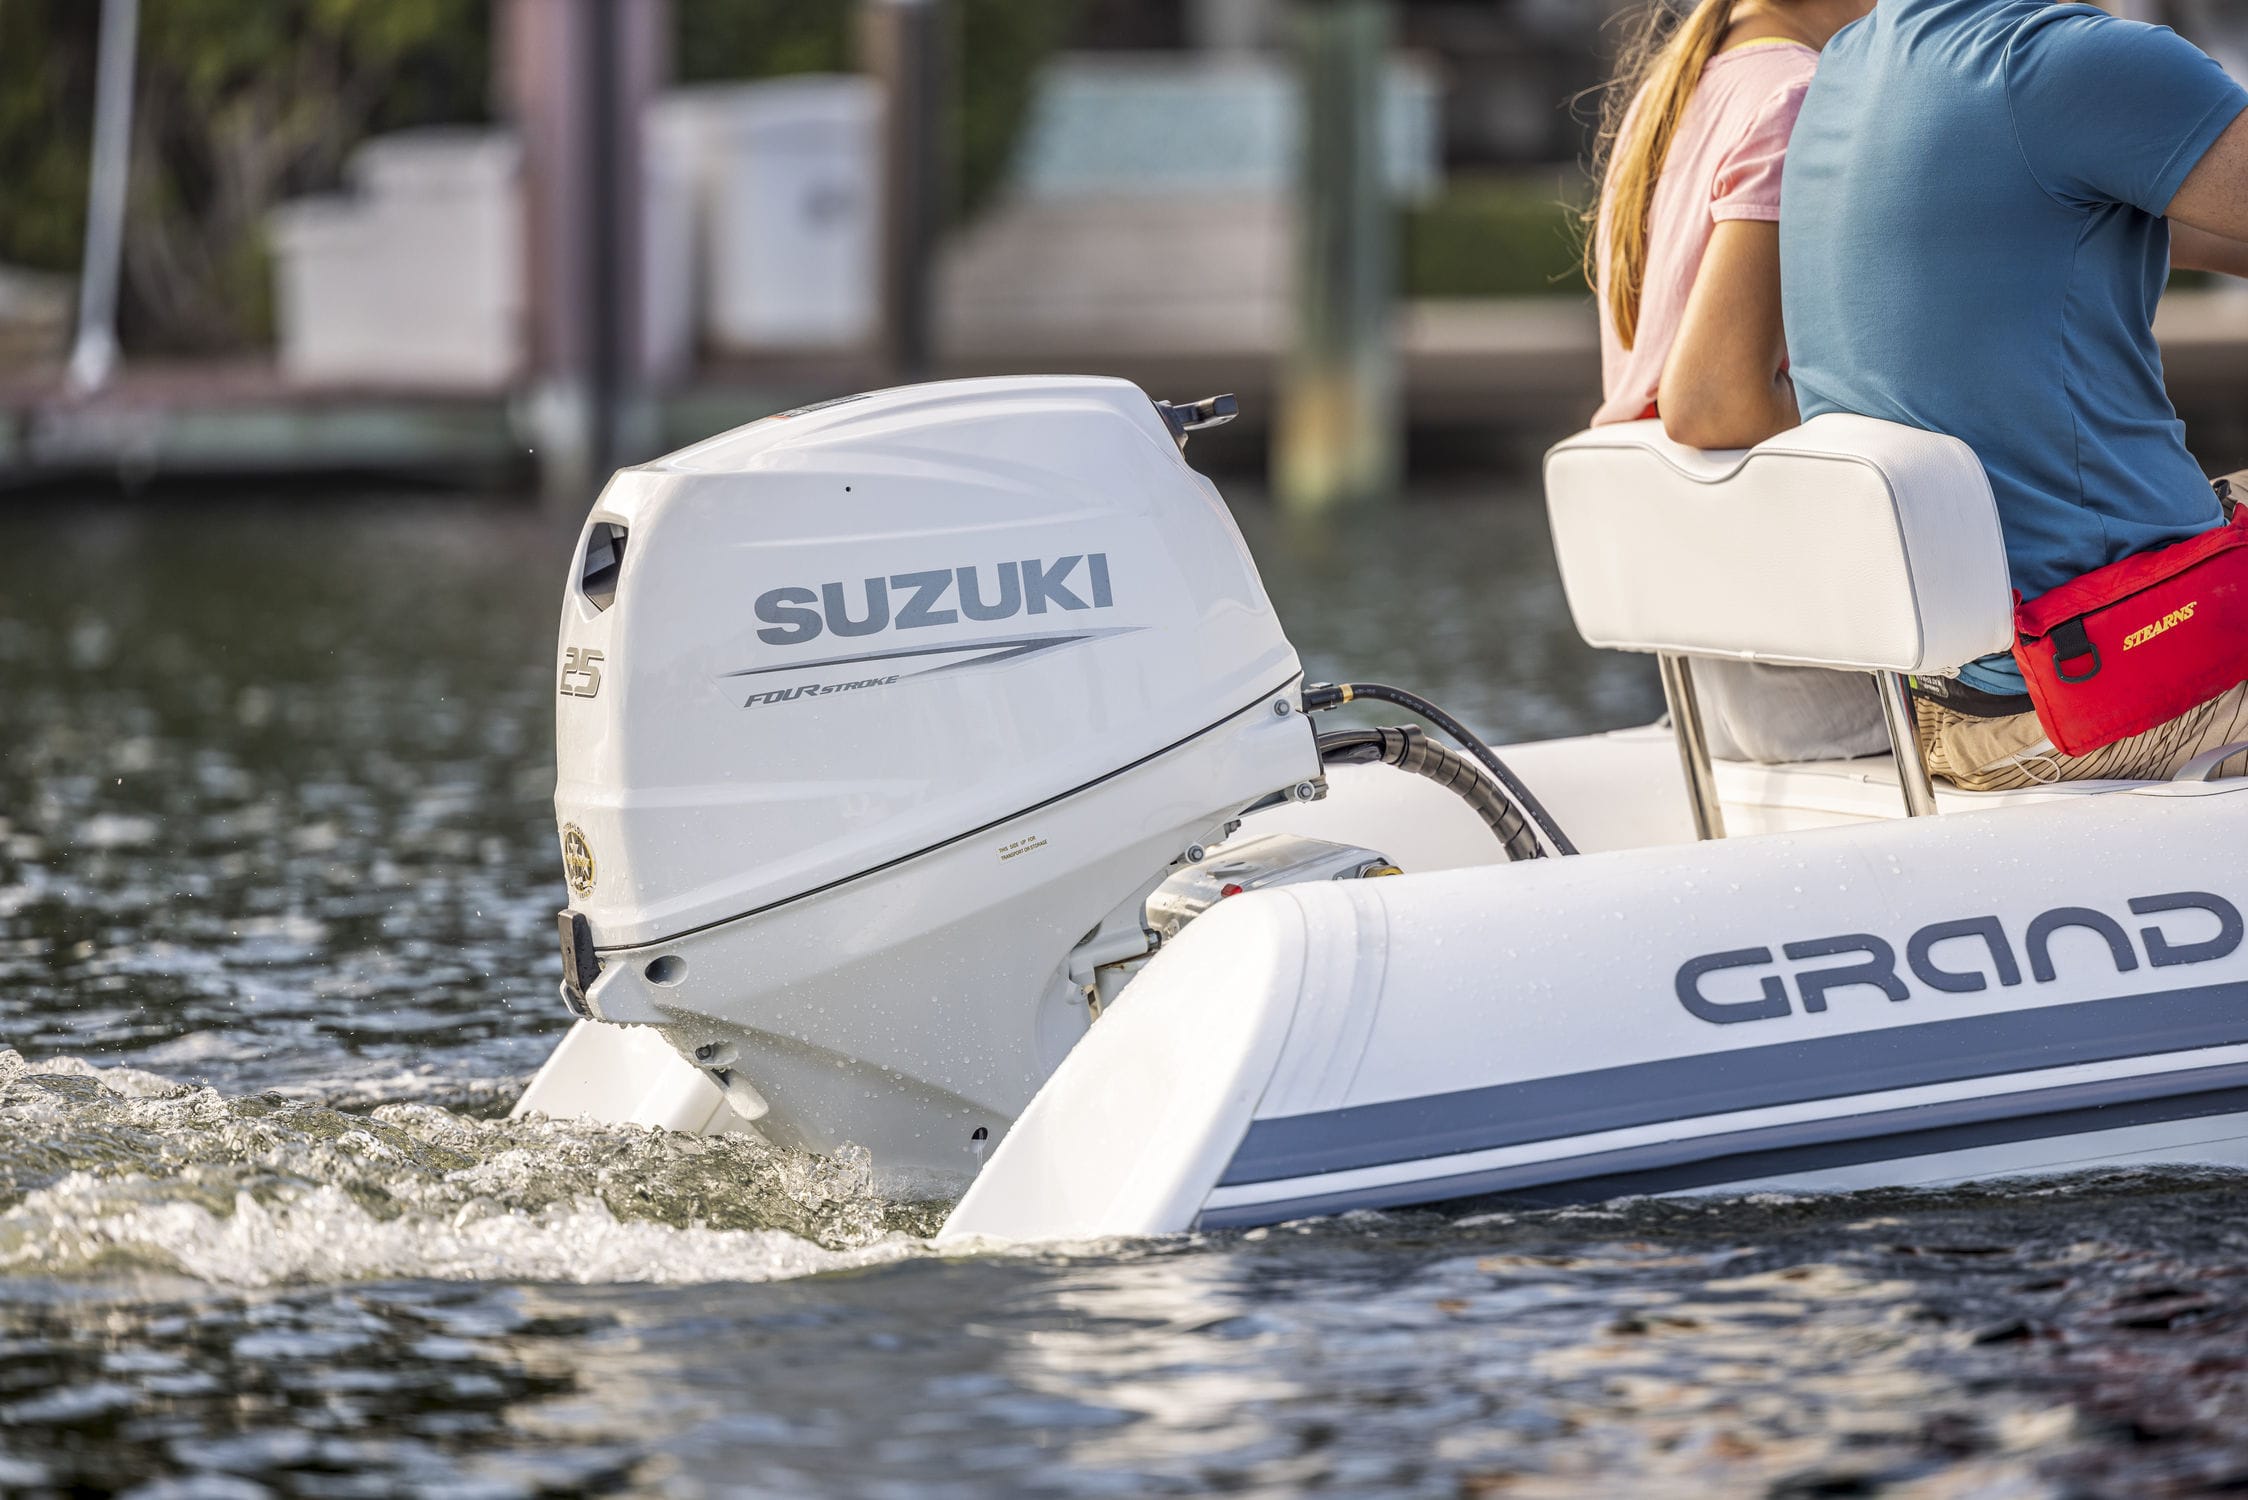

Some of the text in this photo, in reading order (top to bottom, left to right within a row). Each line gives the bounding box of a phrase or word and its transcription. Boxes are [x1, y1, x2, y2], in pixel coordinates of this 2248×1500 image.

[754, 553, 1113, 646] SUZUKI
[2123, 601, 2196, 651] STEARNS
[560, 646, 604, 698] 25
